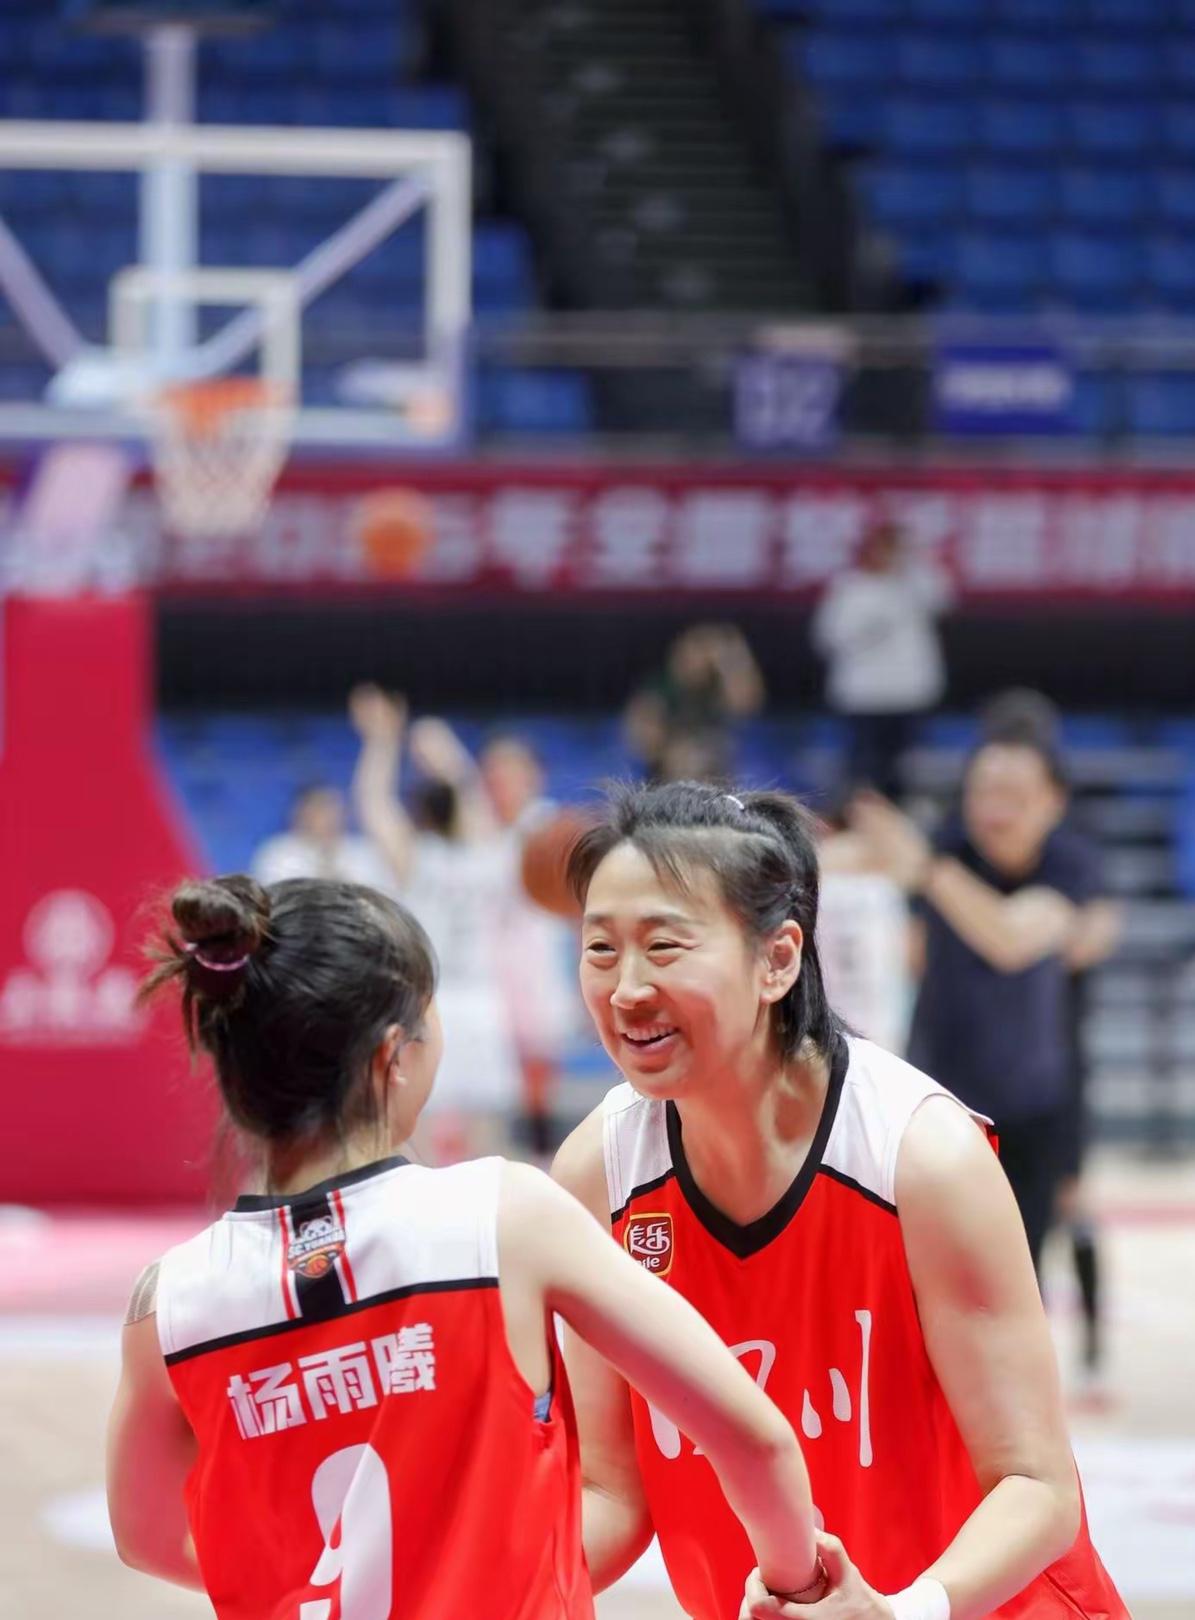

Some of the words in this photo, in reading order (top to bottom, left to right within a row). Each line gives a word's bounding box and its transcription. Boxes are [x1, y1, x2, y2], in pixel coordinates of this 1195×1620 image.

[227, 1322, 436, 1440] 杨雨曦
[300, 1443, 393, 1620] 9
